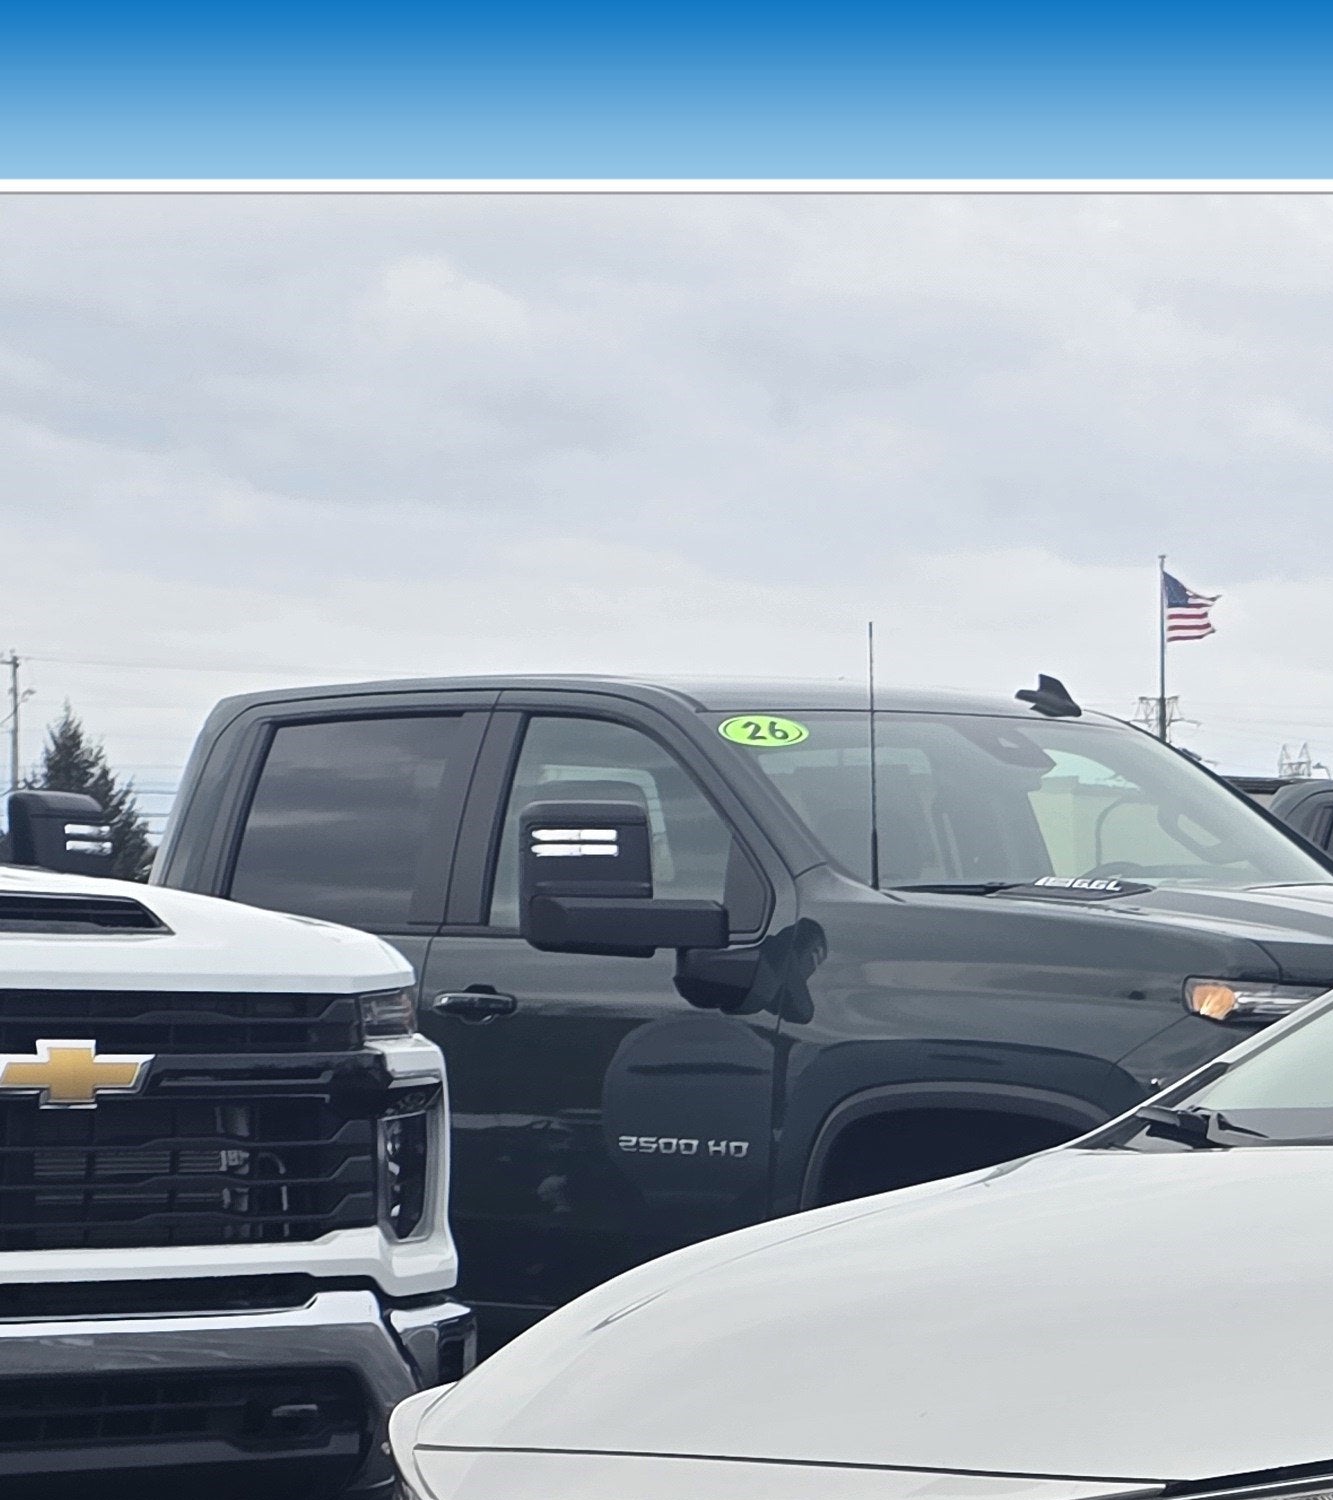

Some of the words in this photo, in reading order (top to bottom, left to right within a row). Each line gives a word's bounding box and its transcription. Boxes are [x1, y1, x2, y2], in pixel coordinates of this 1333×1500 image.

[740, 720, 789, 740] 26
[618, 1135, 699, 1155] 2500
[707, 1139, 750, 1158] HD
